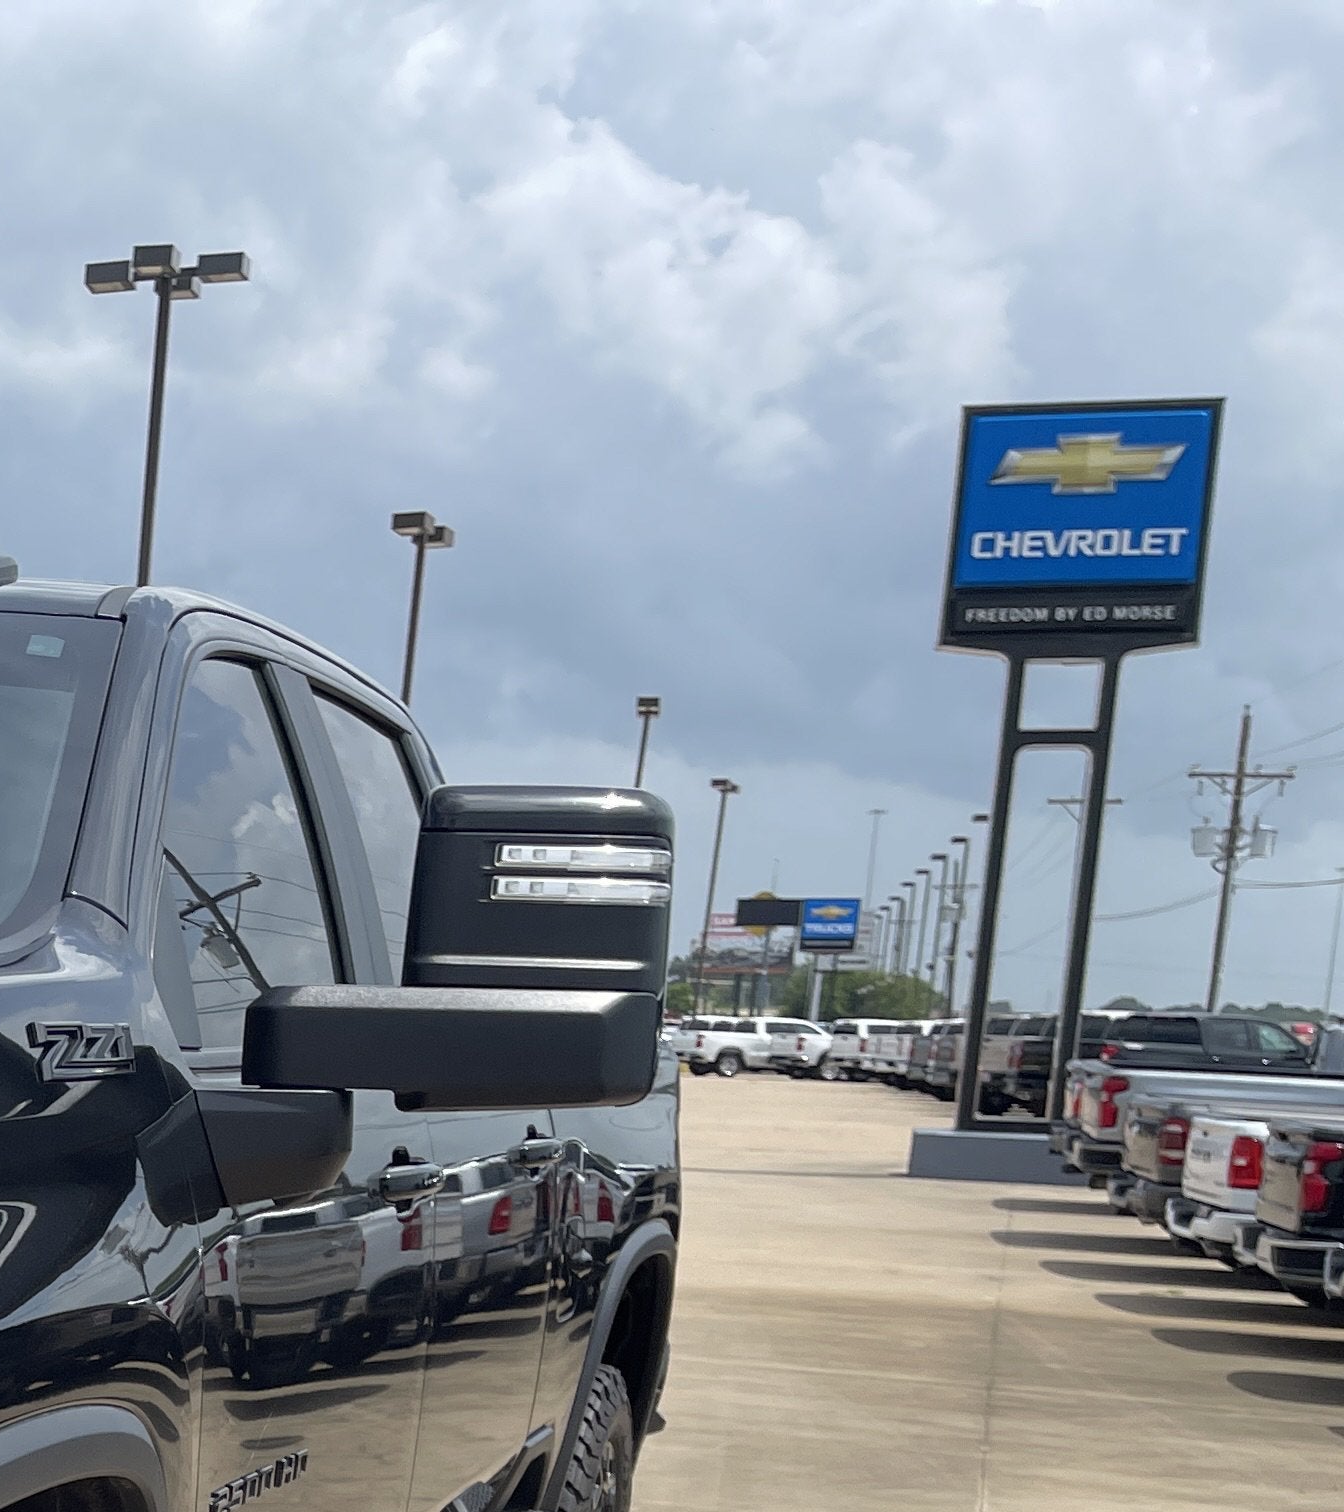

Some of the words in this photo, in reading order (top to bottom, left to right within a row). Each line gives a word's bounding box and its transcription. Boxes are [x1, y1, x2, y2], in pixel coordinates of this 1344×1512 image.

[970, 527, 1190, 560] CHEVROLET
[964, 606, 1050, 623] FREEDOM
[1054, 605, 1079, 622] BY
[1082, 605, 1108, 621] ED
[1112, 604, 1178, 621] MORSE
